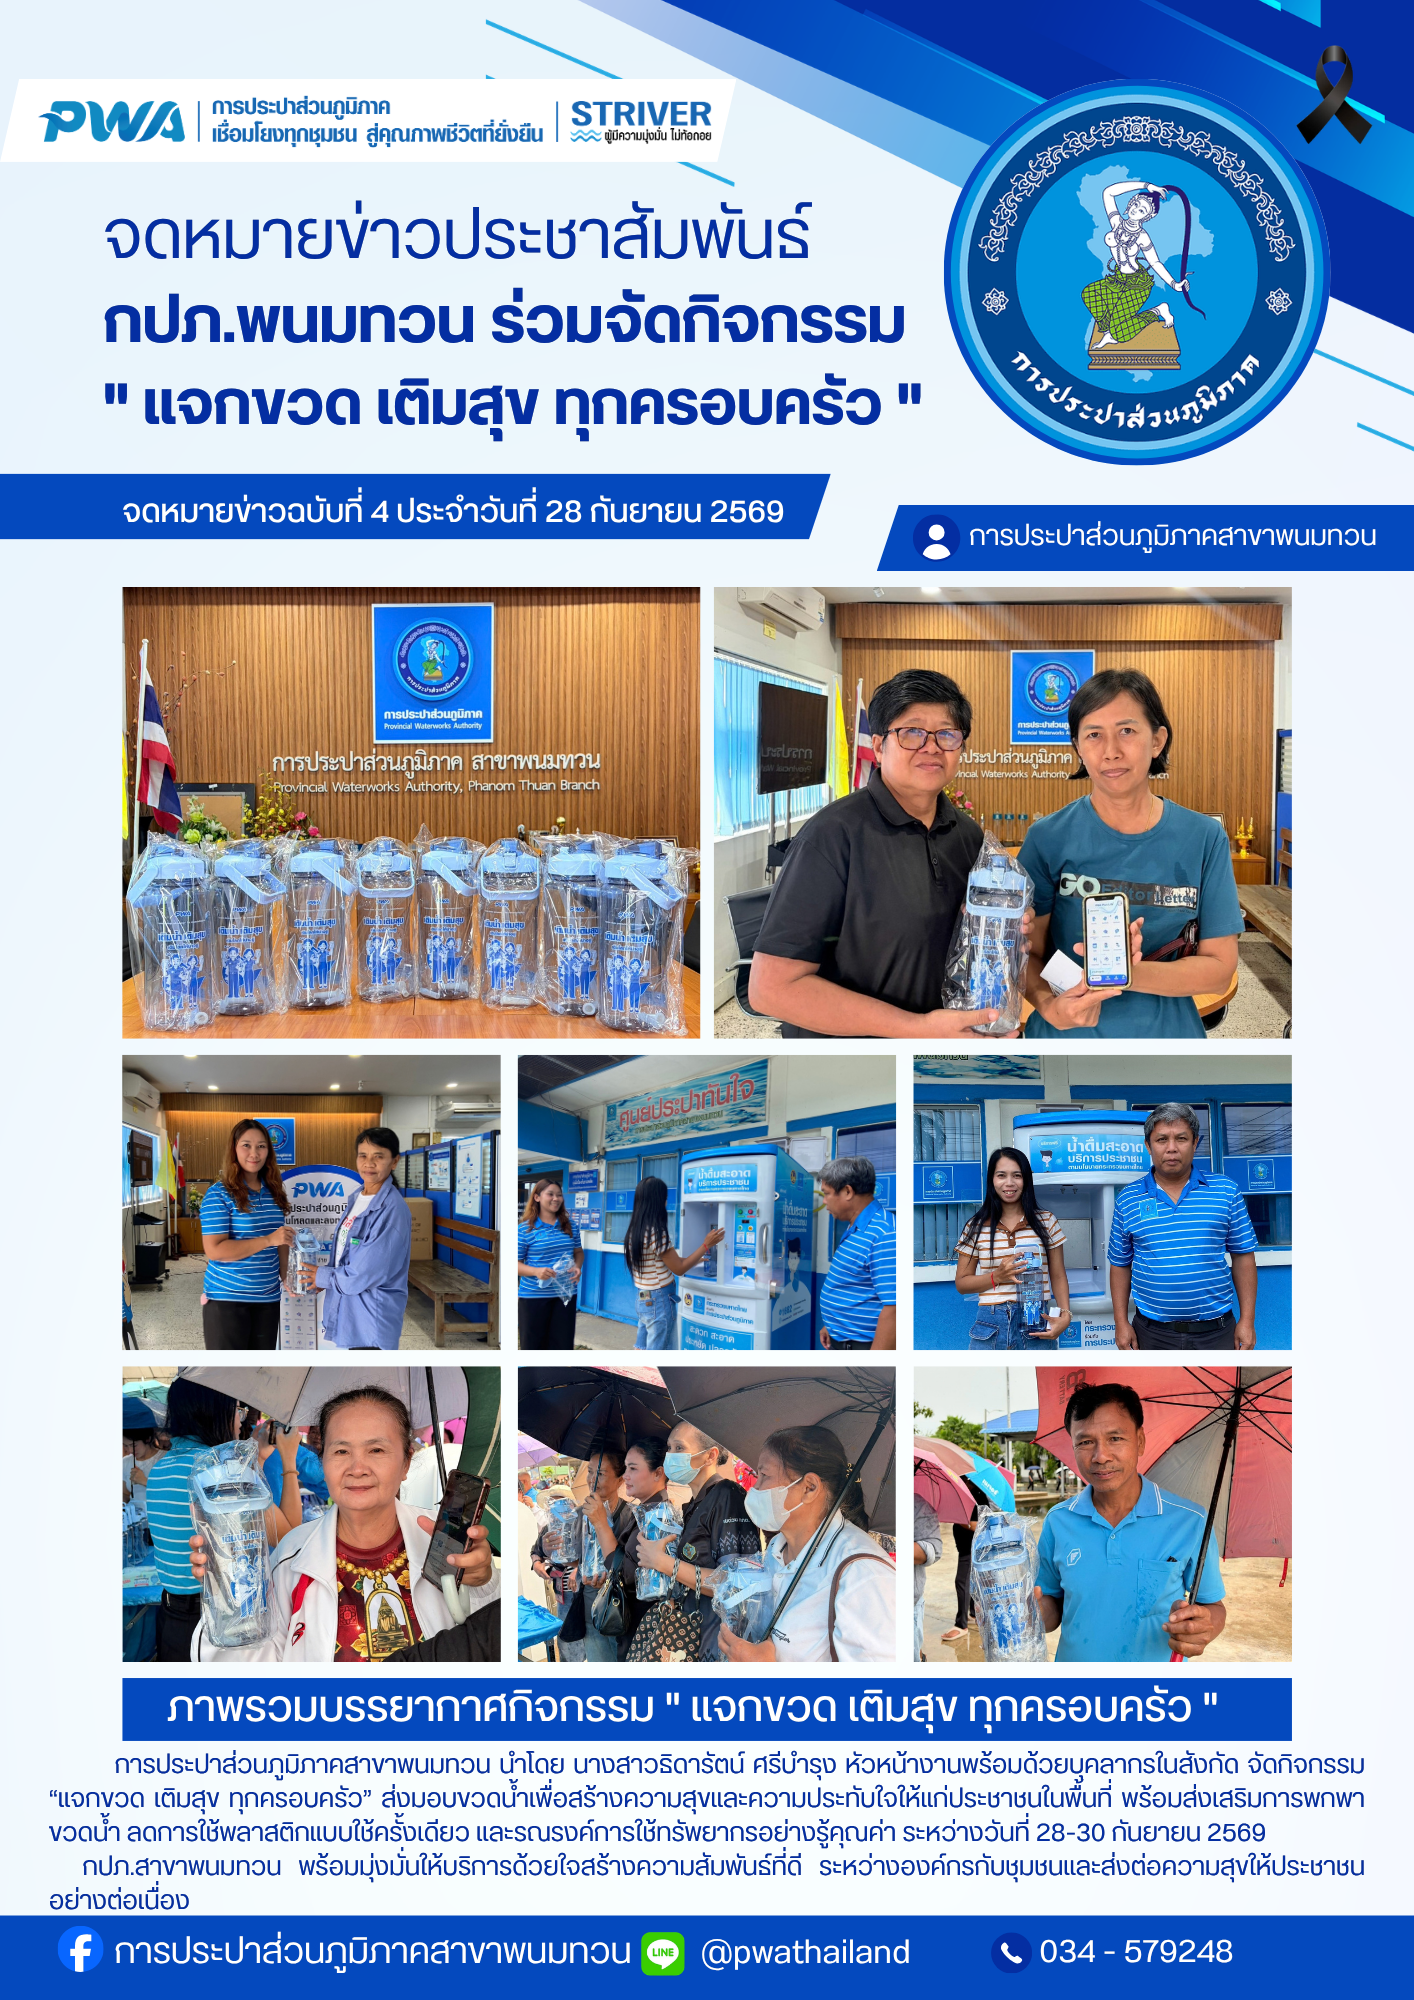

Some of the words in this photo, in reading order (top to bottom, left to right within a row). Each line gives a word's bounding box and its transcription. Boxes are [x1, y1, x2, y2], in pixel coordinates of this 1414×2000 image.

[384, 708, 483, 721] การประปาส่วนภูมิภาค
[384, 722, 413, 730] Provincial
[414, 722, 451, 730] Waterworks
[453, 721, 483, 731] Authority
[272, 748, 463, 779] การประปาส่วนภูมิภาค
[471, 751, 601, 771] สาขาพนมทวน
[981, 770, 1028, 778] Waterworks
[274, 780, 327, 794] Provincial
[332, 780, 400, 793] Waterworks
[405, 779, 463, 795] Authority,
[468, 779, 515, 792] Phanom
[518, 779, 556, 791] Thuan
[560, 779, 600, 791] Branch
[1059, 872, 1101, 897] GO
[619, 1073, 755, 1133] ศูนย์ประปาทันใจ
[1067, 1136, 1144, 1153] น้ำดื่มสะอาด
[1068, 1154, 1143, 1163] บริการประชาชน
[291, 1181, 345, 1198] PWA
